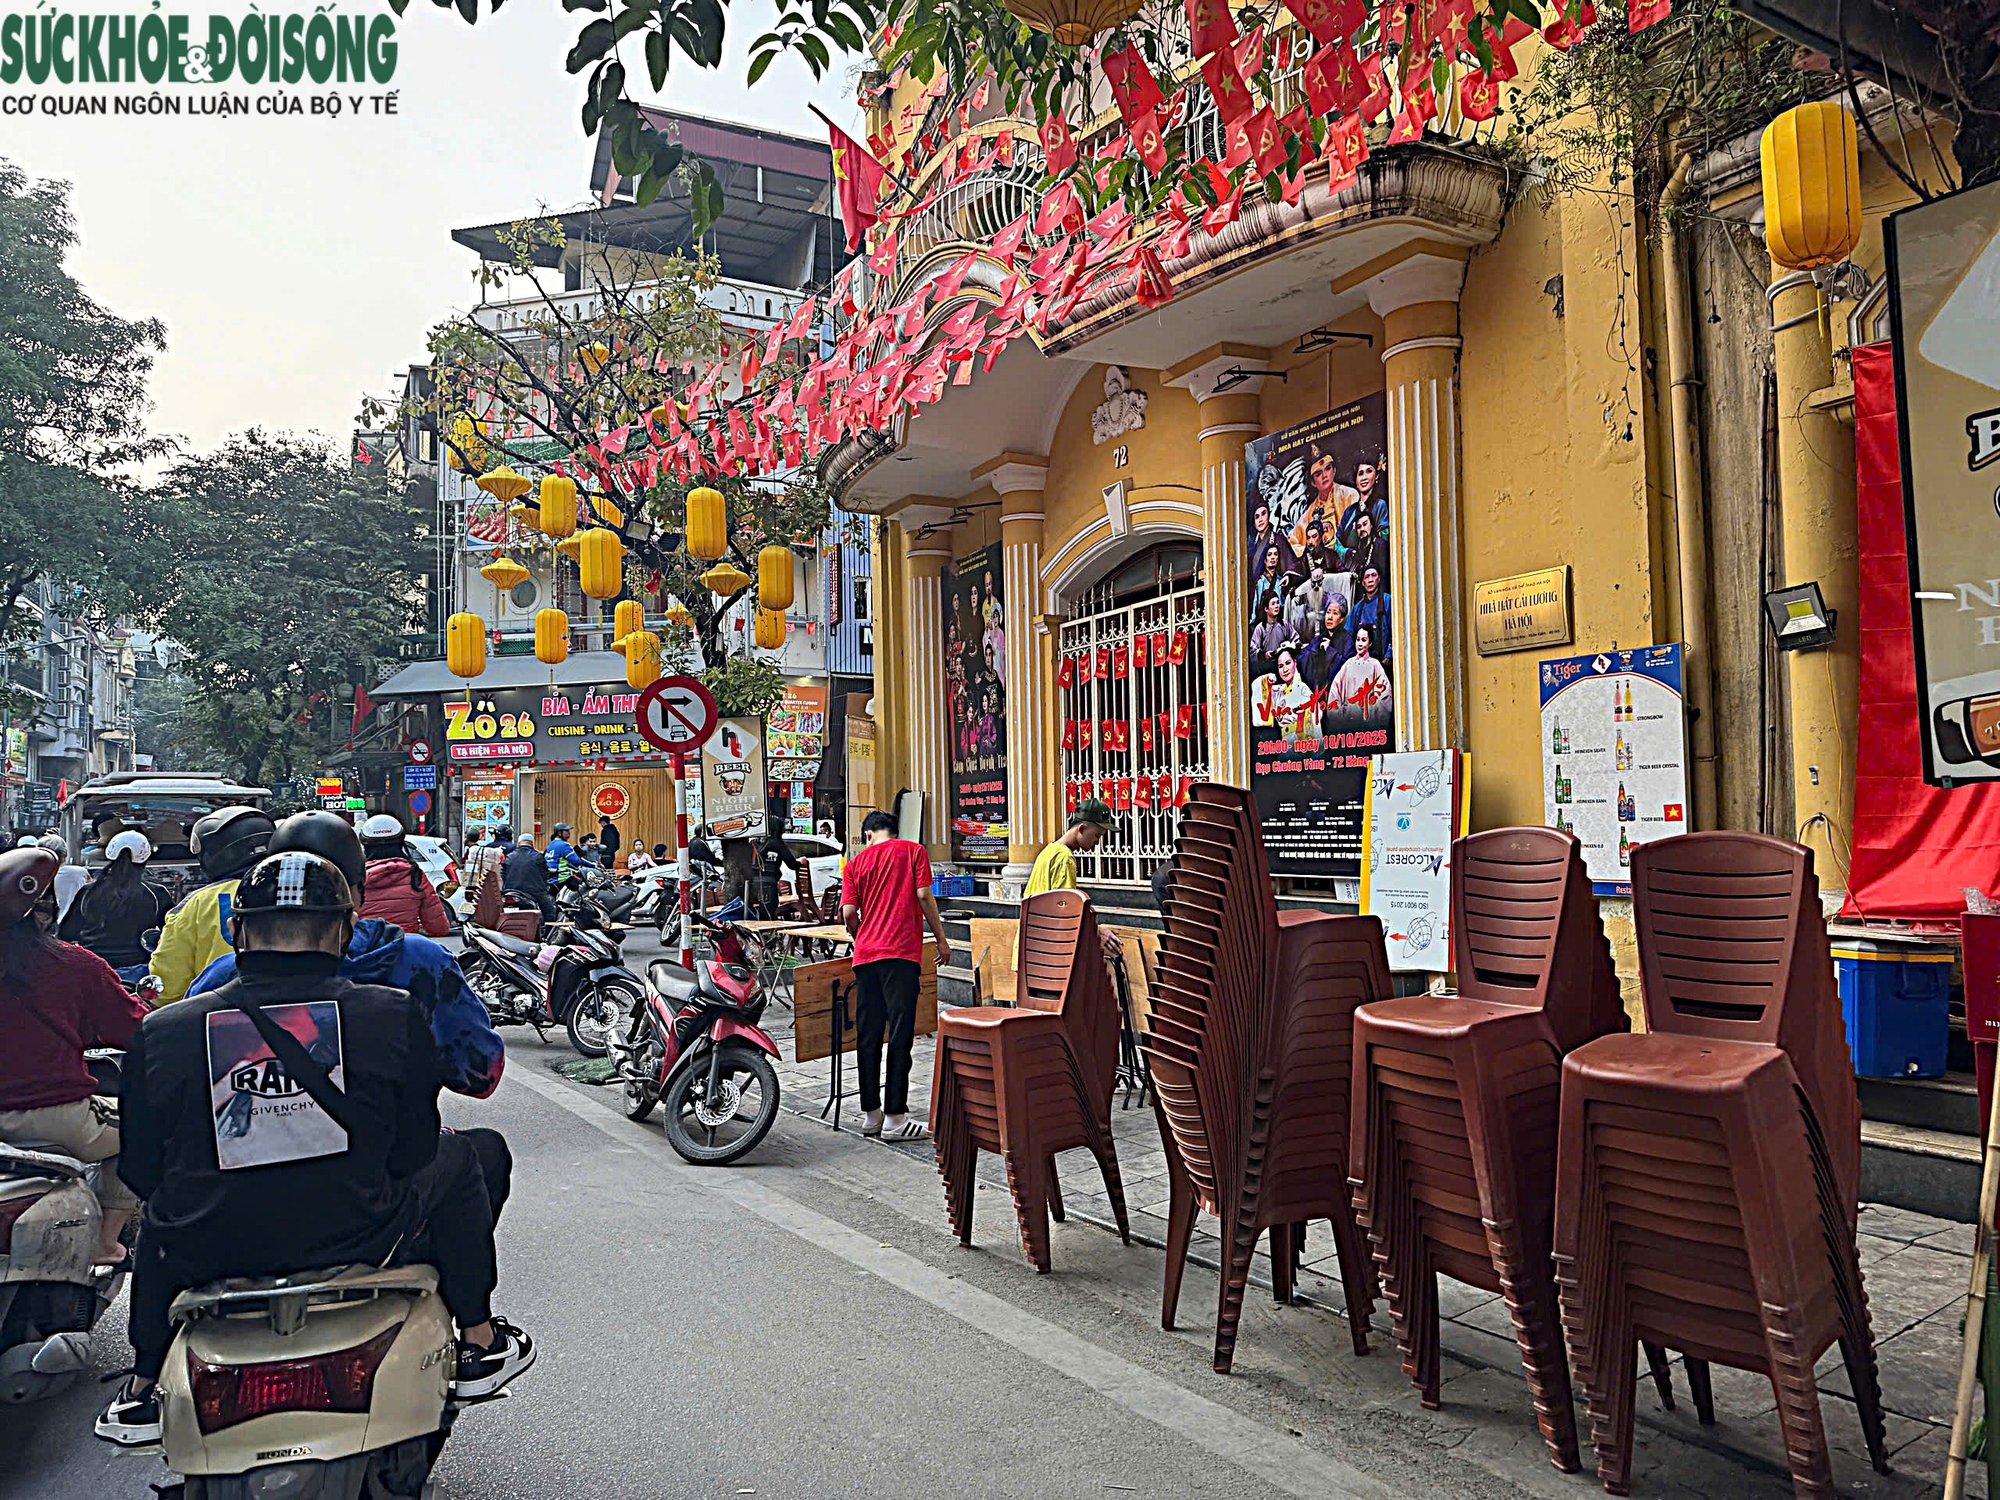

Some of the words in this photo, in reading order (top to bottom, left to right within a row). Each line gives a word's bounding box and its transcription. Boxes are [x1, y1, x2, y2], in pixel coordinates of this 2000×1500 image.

[1113, 445, 1128, 468] 72
[1504, 615, 1517, 631] HÀ
[1517, 612, 1533, 630] NỘI
[1798, 635, 1812, 643] LED
[582, 686, 610, 715] ẨM
[612, 693, 642, 714] TH
[500, 710, 536, 739] 26
[547, 725, 586, 737] CUISINE
[594, 723, 625, 735] DRINK
[580, 741, 602, 755] 음식
[609, 740, 632, 754] 음료
[1294, 737, 1321, 753] ngày
[1321, 730, 1388, 750] 18/10/2025
[497, 745, 511, 755] HÀ
[714, 762, 752, 775] BEER
[1303, 757, 1326, 771] Vàng
[1332, 756, 1345, 768] 72
[711, 795, 758, 806] NIGHT
[715, 803, 753, 813] BEER
[1418, 902, 1429, 910] ISO
[250, 1100, 315, 1116] GIVENCHY
[256, 1446, 313, 1461] HONDA
